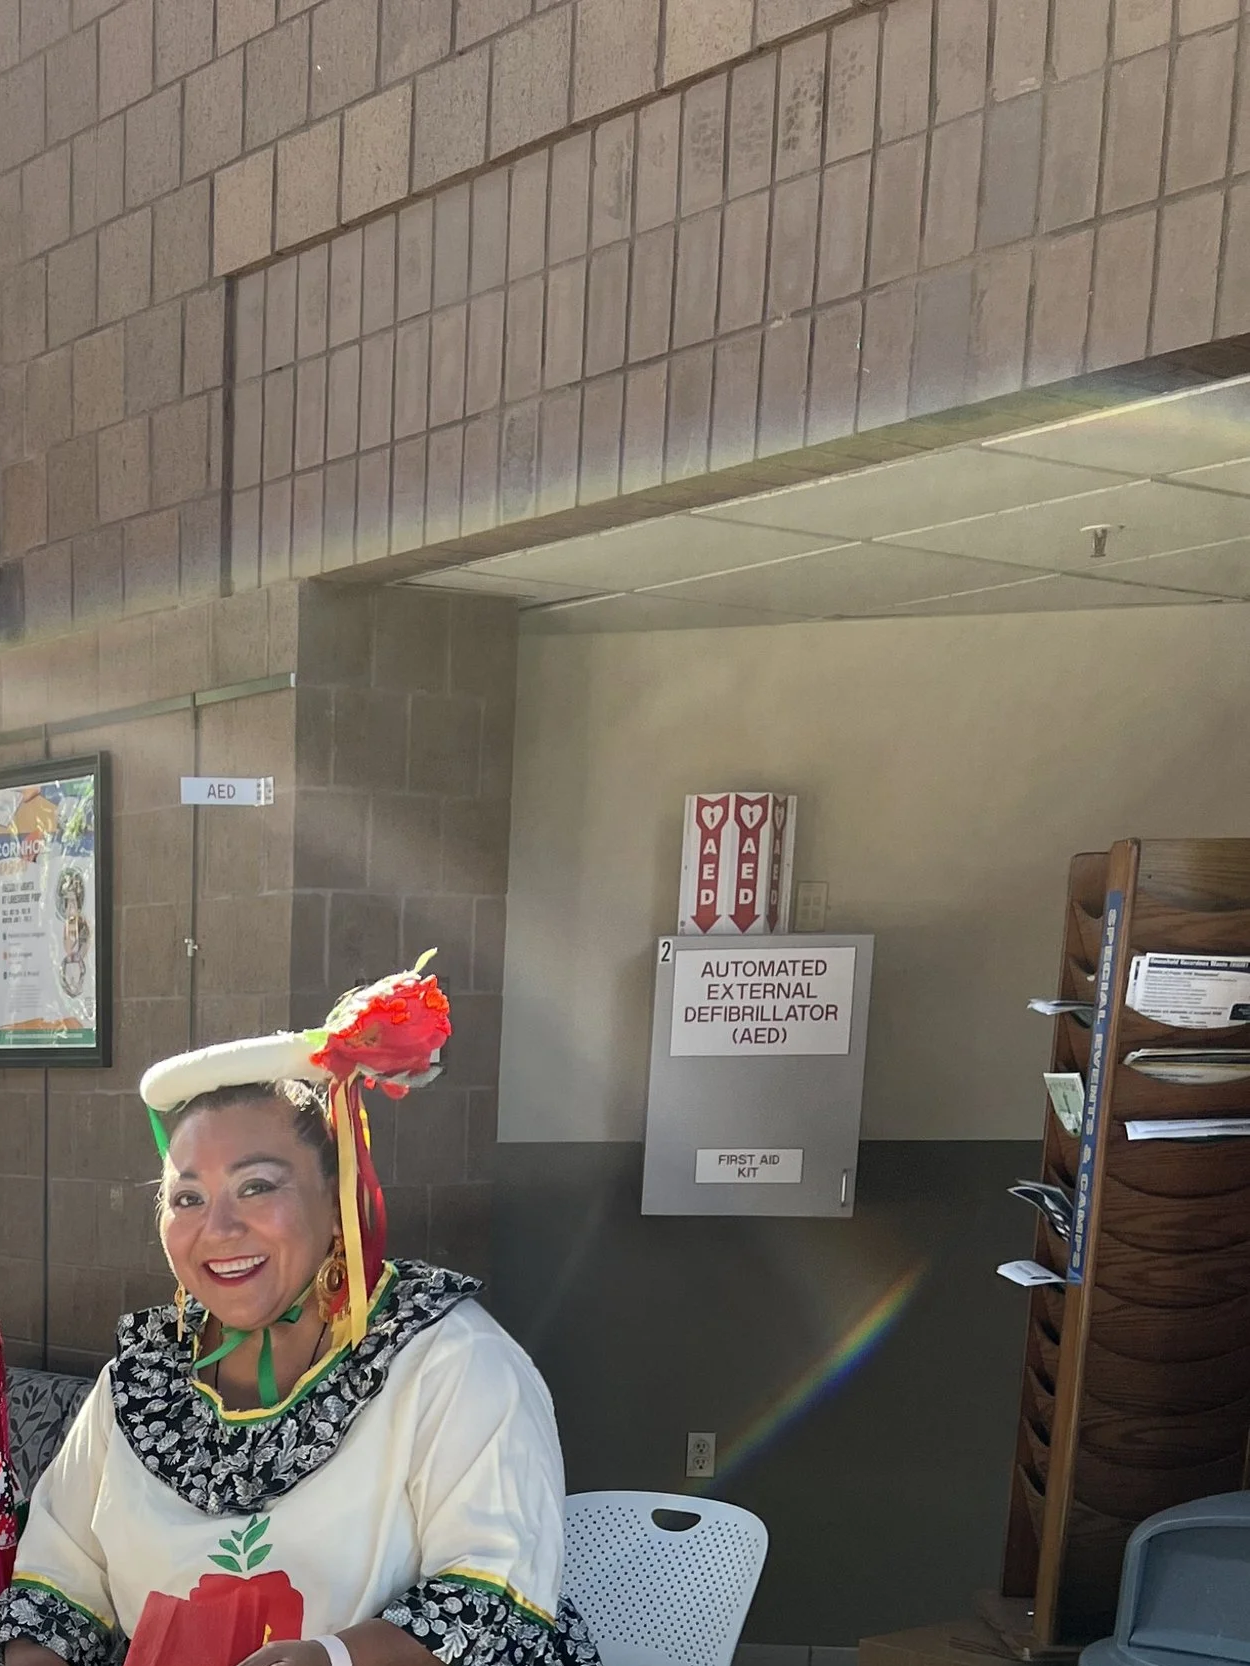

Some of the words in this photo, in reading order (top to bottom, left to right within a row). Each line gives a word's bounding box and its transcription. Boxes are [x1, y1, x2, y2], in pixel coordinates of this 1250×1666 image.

[207, 784, 236, 799] AED
[700, 838, 717, 905] AED
[738, 837, 756, 904] AED
[770, 839, 782, 905] AED
[661, 941, 671, 962] 2
[701, 959, 827, 978] AUTOMATED
[1096, 908, 1117, 1025] SPECIAL
[707, 982, 818, 1000] EXTERNAL
[684, 1004, 839, 1023] DEFIBRILLATOR
[732, 1027, 788, 1045] (AED)
[1084, 1033, 1104, 1136] EVENTS
[717, 1154, 756, 1165] FIRST
[759, 1154, 780, 1165] AID
[1081, 1144, 1092, 1165] &
[737, 1167, 759, 1178] KIT
[1072, 1173, 1089, 1269] CAMPS
